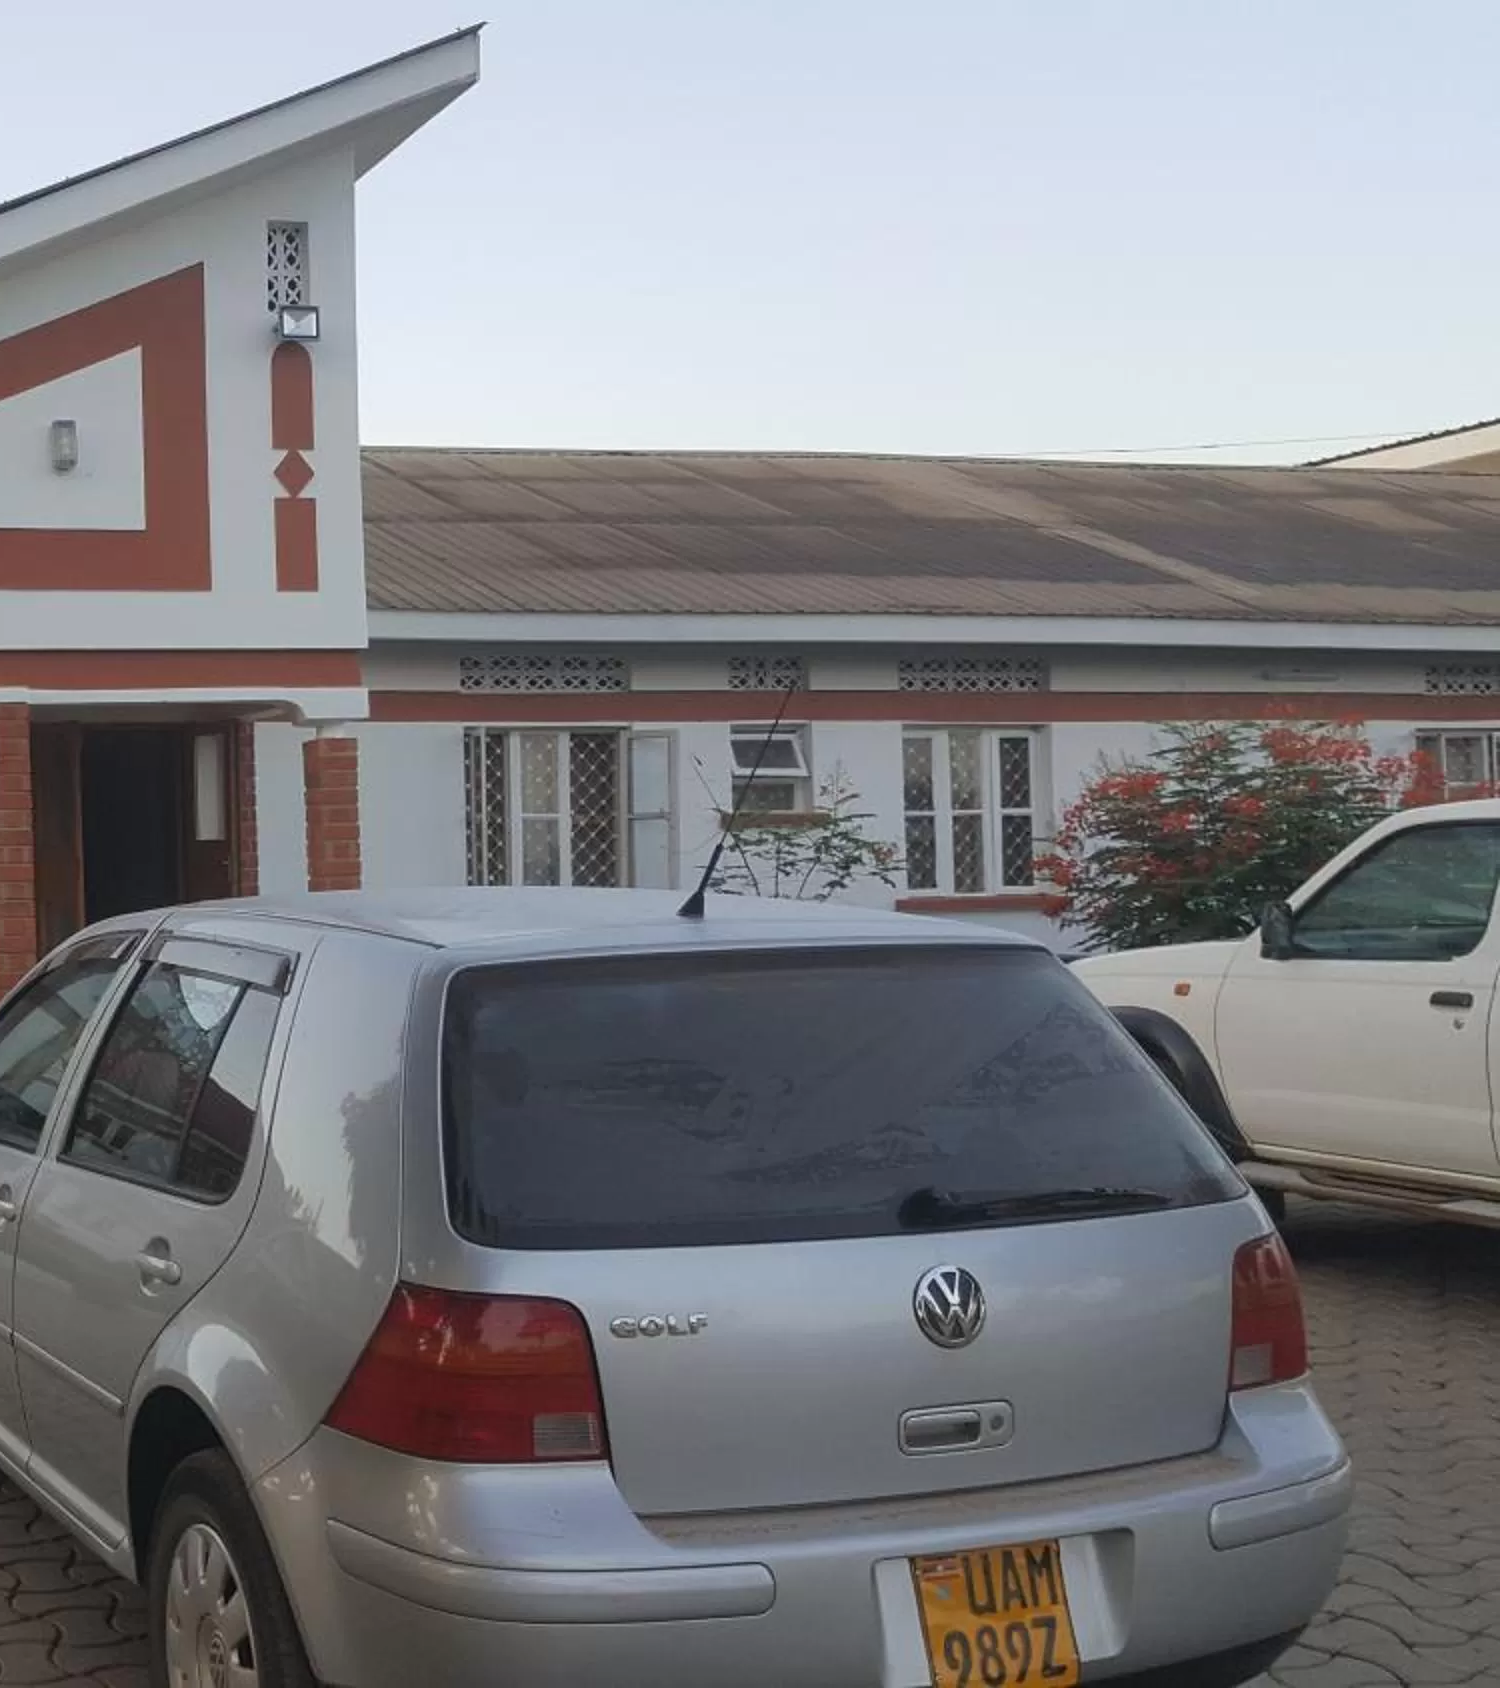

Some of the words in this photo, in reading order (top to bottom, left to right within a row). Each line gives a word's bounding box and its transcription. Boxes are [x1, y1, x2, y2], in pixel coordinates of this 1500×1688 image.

[609, 1312, 709, 1339] GOLF
[962, 1545, 1059, 1616] UAM
[943, 1615, 1068, 1688] 989Z
